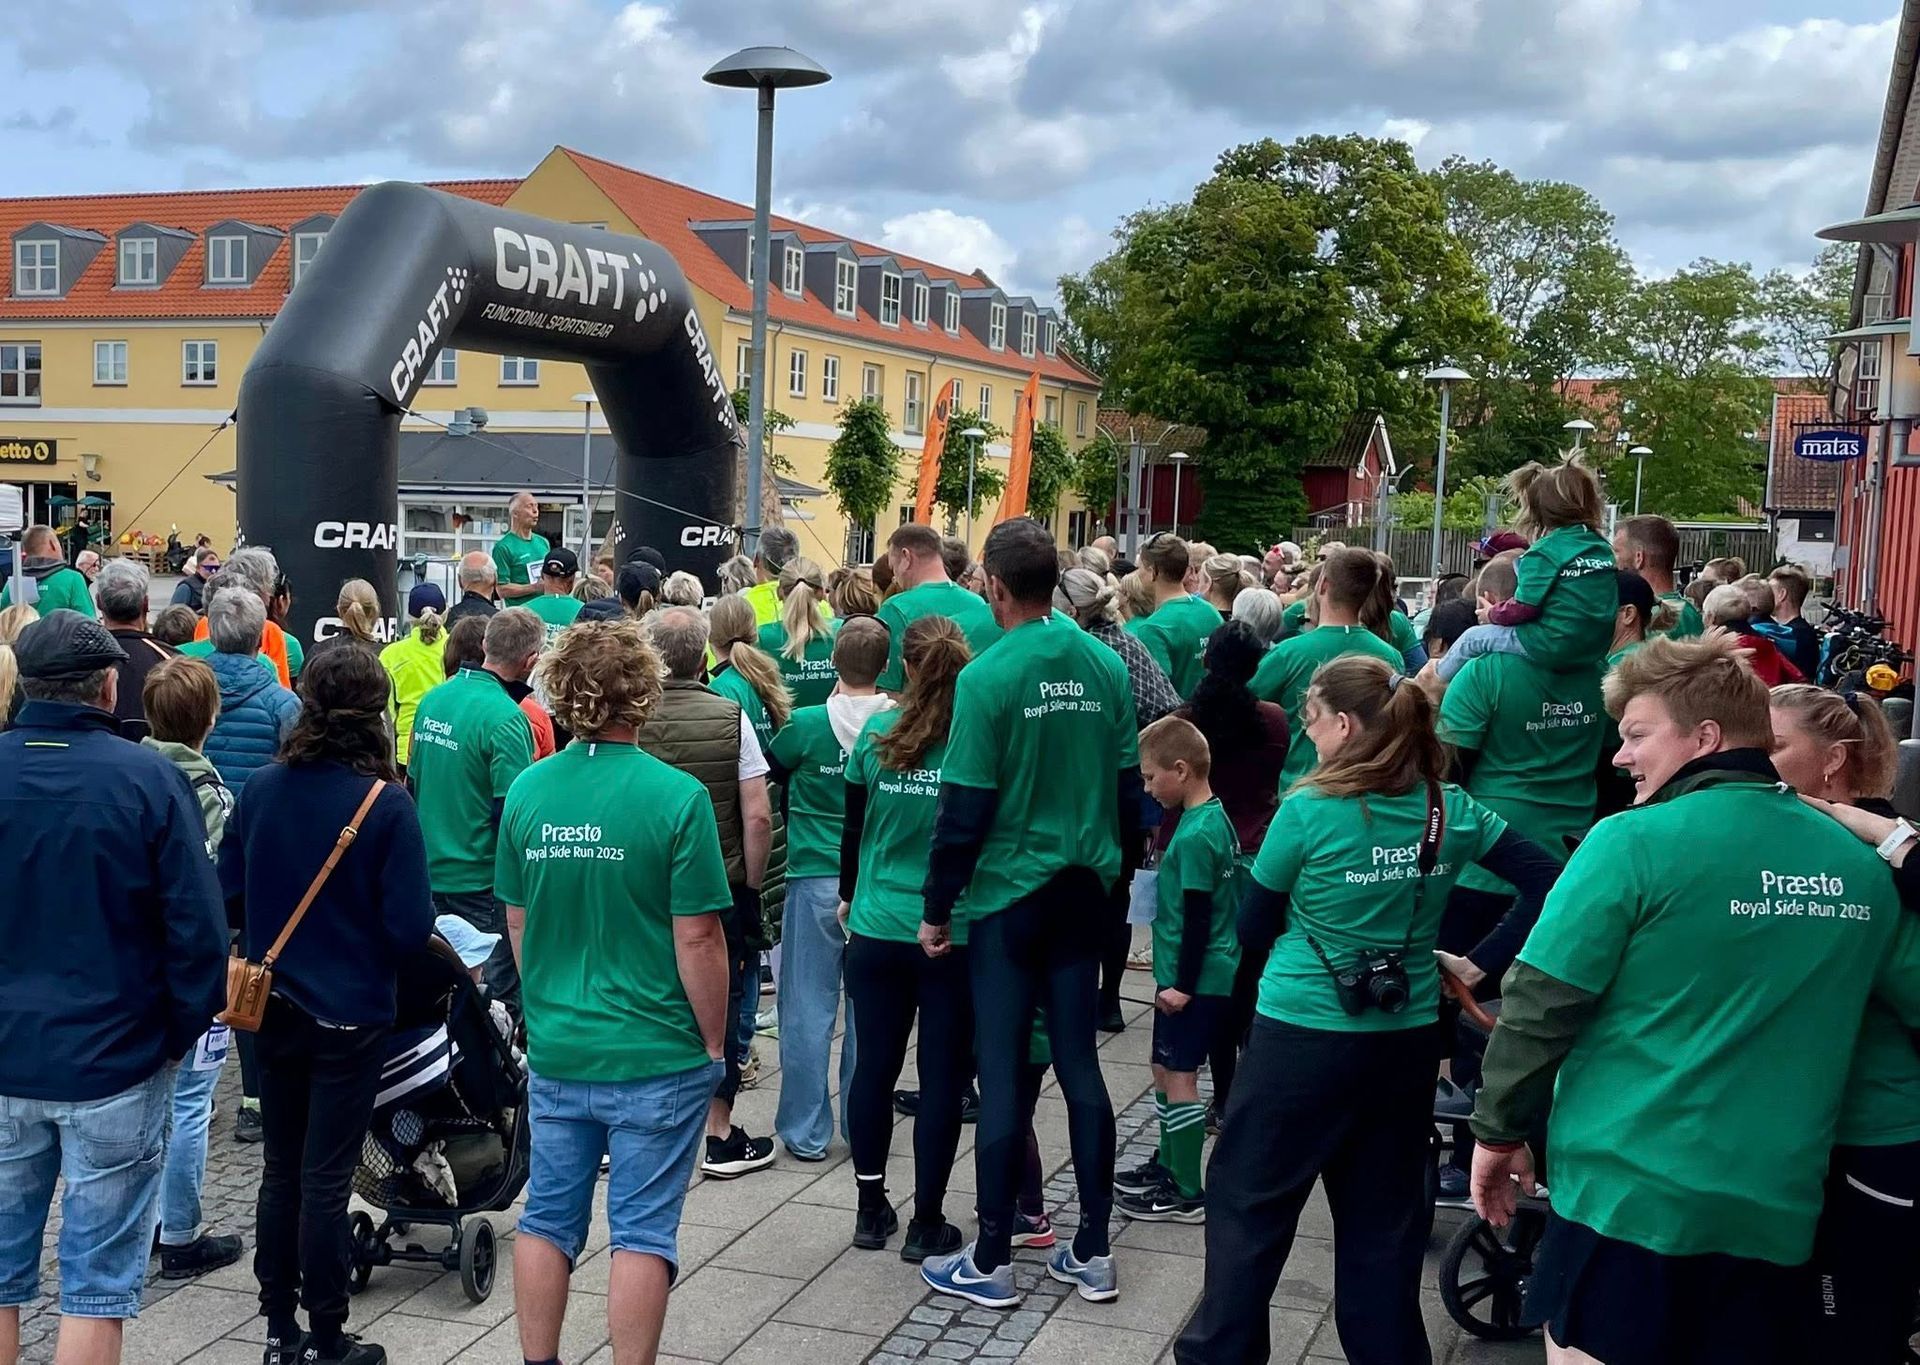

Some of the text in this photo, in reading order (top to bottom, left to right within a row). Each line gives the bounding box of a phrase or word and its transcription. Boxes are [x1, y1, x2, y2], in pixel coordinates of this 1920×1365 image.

[493, 227, 630, 310] CRAFT
[480, 303, 615, 339] FUNCTIONAL SPORTSWEAR
[390, 281, 450, 402] CRAFT
[684, 308, 726, 403] CRAFT
[0, 443, 31, 459] etto
[1801, 437, 1859, 456] matas
[314, 521, 398, 550] CRAF
[680, 526, 735, 547] CRA
[313, 617, 399, 643] CAF
[785, 672, 805, 682] Royal
[820, 671, 832, 680] Run
[1079, 700, 1101, 712] 2025
[820, 765, 844, 775] Royal
[879, 781, 939, 797] Royal Side Ru
[541, 823, 602, 842] Præstø
[1428, 807, 1441, 843] Canon
[525, 845, 624, 862] Royal Side Run 2025
[1372, 842, 1421, 866] Præst
[1345, 869, 1379, 886] Royal
[1381, 867, 1404, 881] Side
[1406, 866, 1421, 878] Ru
[1761, 870, 1844, 896] Præstø
[1730, 898, 1871, 921] Royal Side Run 2025
[1822, 1274, 1837, 1315] FUSION
